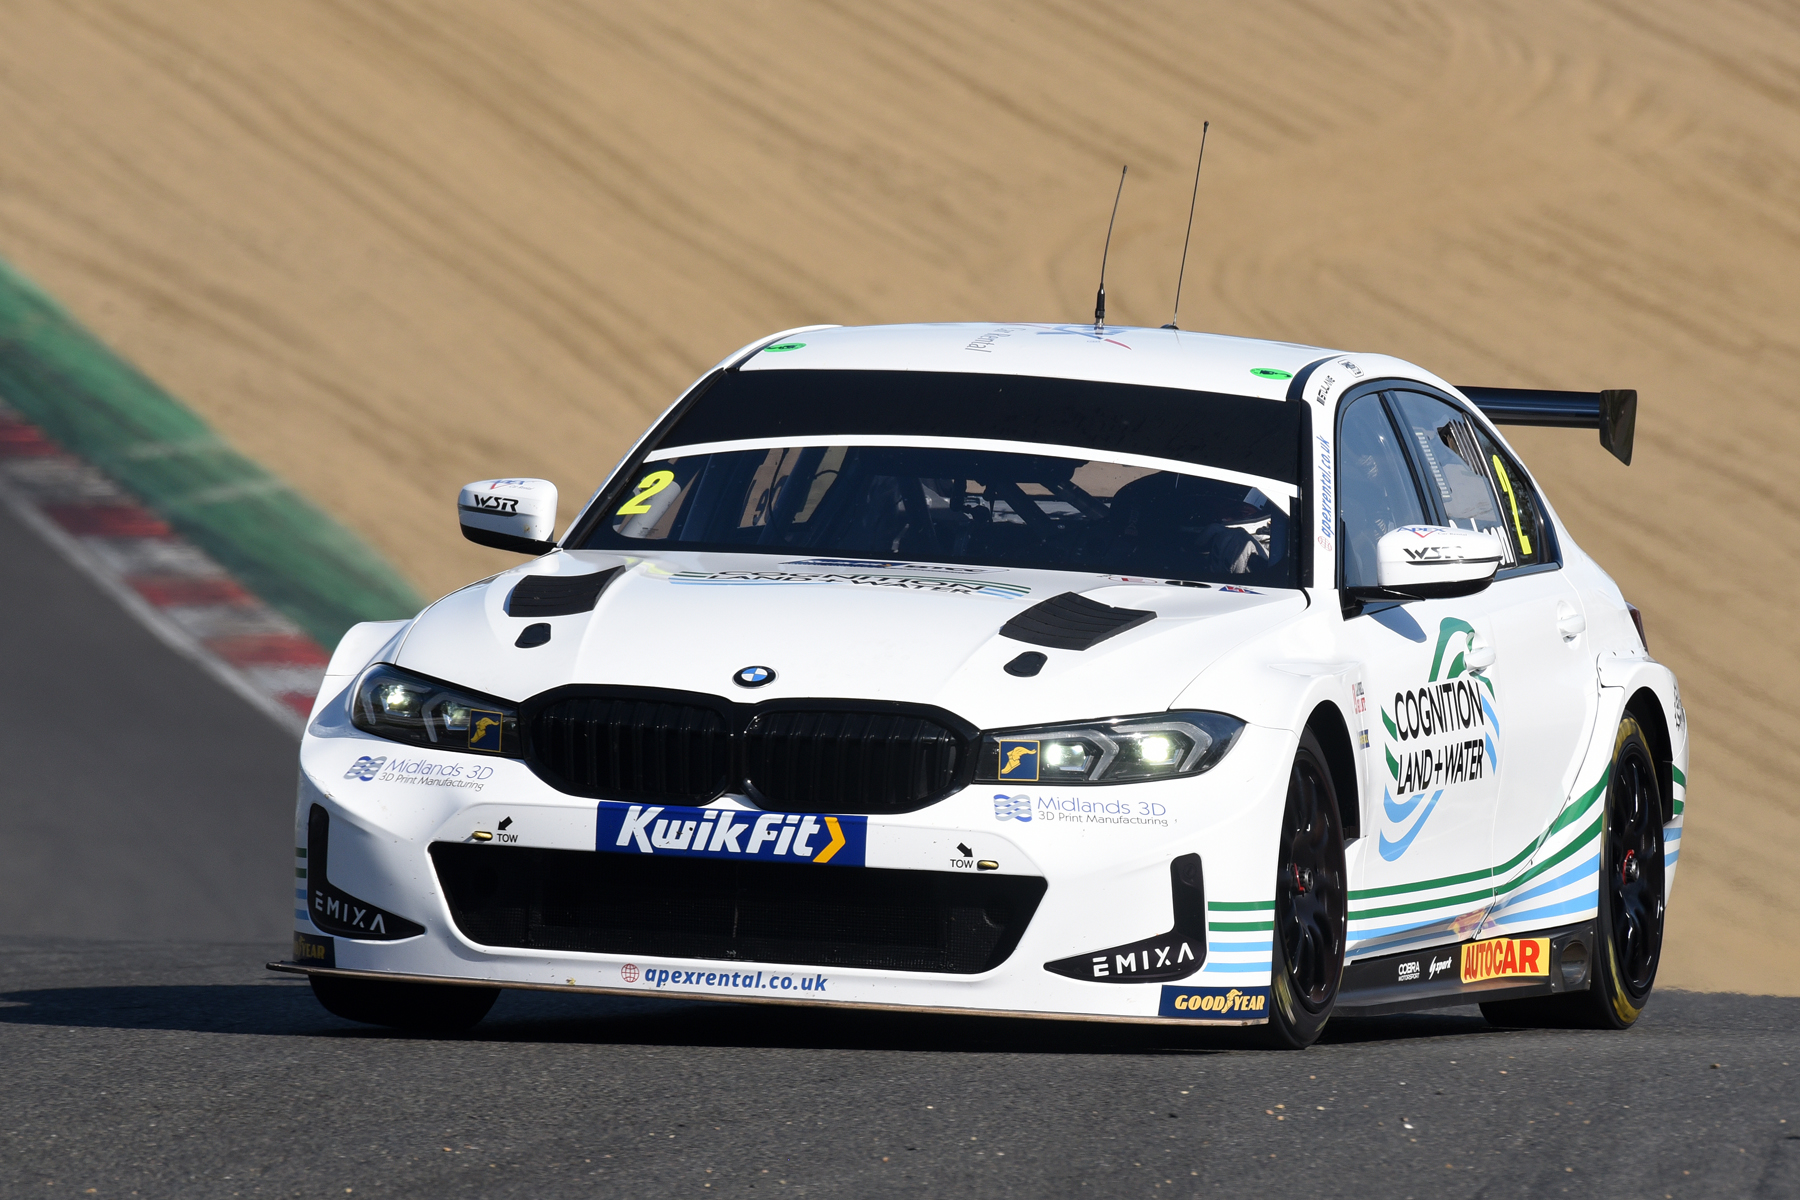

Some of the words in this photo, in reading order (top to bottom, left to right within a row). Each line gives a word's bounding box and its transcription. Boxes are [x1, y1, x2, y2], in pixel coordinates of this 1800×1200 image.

[616, 470, 674, 516] 2
[1316, 435, 1334, 538] apexrental.co.uk
[473, 494, 519, 513] WSR
[719, 570, 986, 591] COGNITION
[1394, 680, 1485, 741] COGNITION
[384, 758, 463, 778] Midlands
[466, 765, 494, 780] 3D
[378, 772, 394, 784] 3D
[396, 774, 418, 787] Print
[419, 777, 485, 792] Manufacturing
[1037, 796, 1131, 815] Midlands
[1139, 801, 1167, 817] 3D
[1038, 811, 1055, 821] 3D
[1058, 813, 1083, 823] Print
[1086, 815, 1169, 827] Manufacturing
[497, 833, 519, 843] TOW
[950, 858, 974, 869] TOW
[314, 890, 387, 935] EMIXA
[1092, 942, 1195, 978] EMIXA
[1398, 961, 1421, 974] COBRA
[1464, 939, 1540, 981] AUTOCAR
[645, 967, 828, 991] apexrental.co.uk
[1175, 990, 1265, 1012] GOODYEAR
